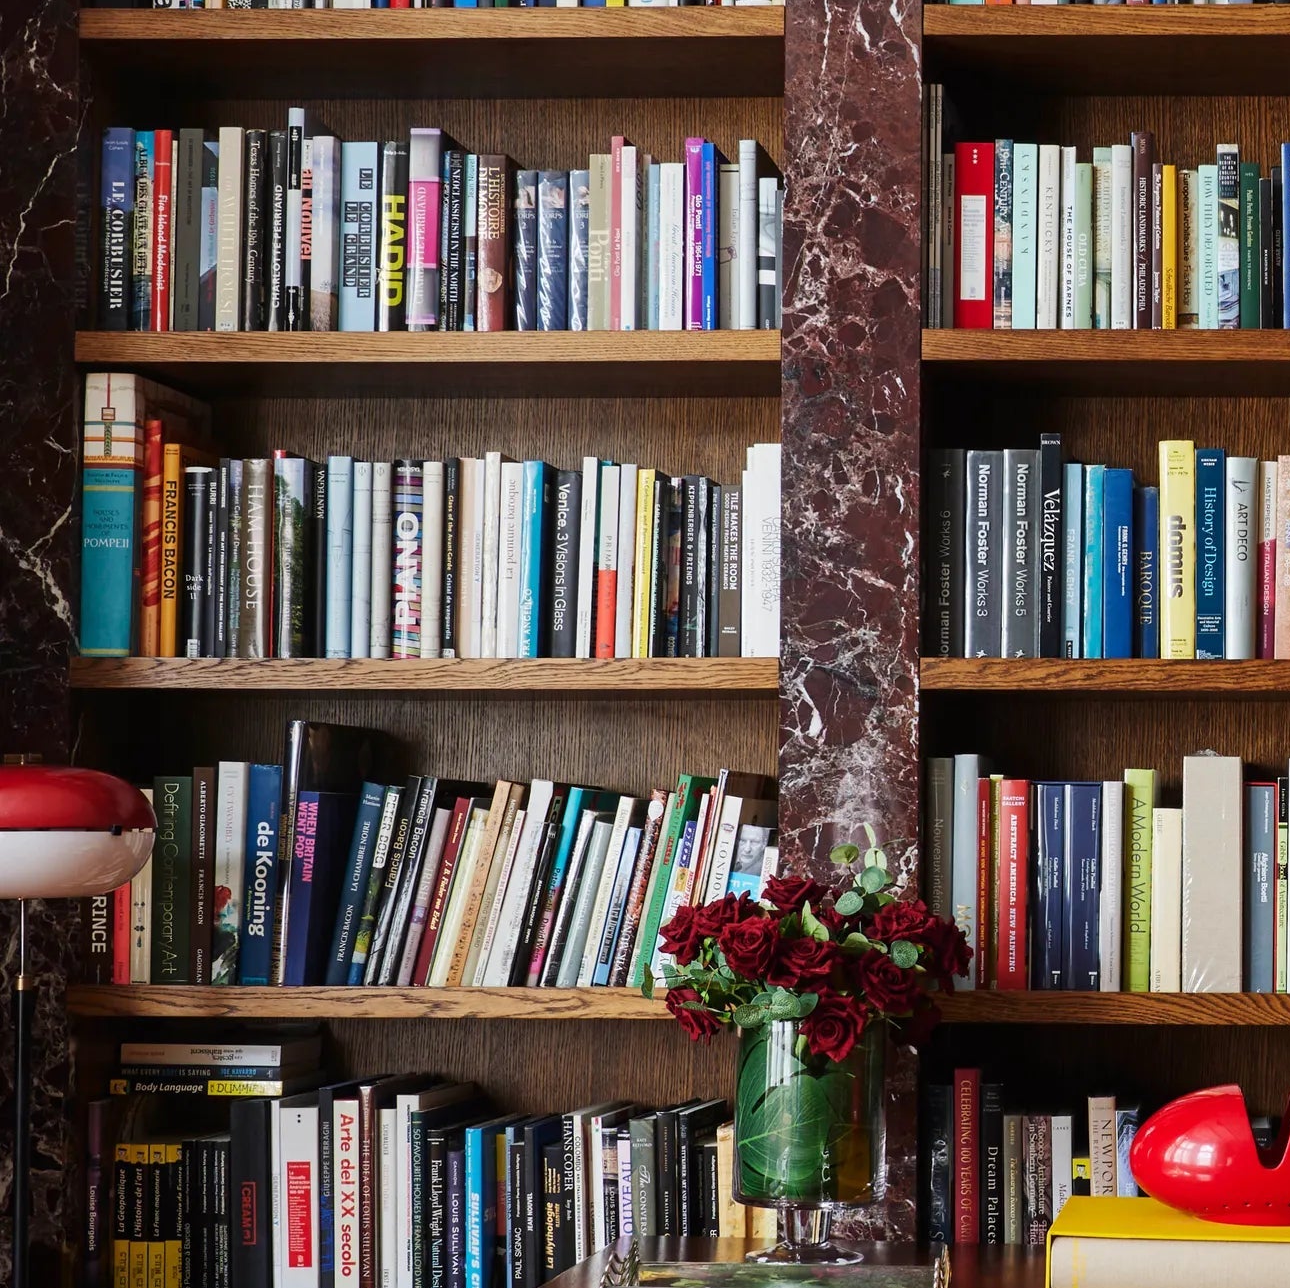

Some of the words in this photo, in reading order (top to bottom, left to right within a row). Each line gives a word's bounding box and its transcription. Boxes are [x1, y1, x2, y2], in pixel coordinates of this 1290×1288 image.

[112, 182, 124, 203] LE
[360, 169, 371, 188] LE
[345, 202, 357, 222] LE
[109, 209, 123, 309] CORBUSIER
[344, 235, 357, 287] GRAND
[359, 202, 371, 297] CORBUSIER
[1078, 233, 1087, 257] OLD
[1077, 260, 1087, 287] CUBA
[247, 485, 262, 533] HAM
[557, 484, 569, 530] Venice.
[1016, 464, 1028, 516] Norman
[164, 481, 176, 544] FRANCIS
[1041, 489, 1059, 571] Velázquez
[1202, 487, 1216, 534] History
[84, 538, 129, 548] POMPEII
[1016, 521, 1028, 564] Foster
[1204, 537, 1215, 550] of
[163, 549, 175, 599] BACON
[246, 541, 262, 609] HOUSE
[395, 512, 418, 624] PIANO
[555, 542, 568, 584] Visions
[1202, 553, 1215, 597] Design
[554, 586, 566, 596] in
[1015, 569, 1027, 606] Works
[1140, 551, 1152, 624] BAROQUE
[553, 599, 566, 631] Glass
[1016, 608, 1026, 616] 5
[296, 801, 307, 832] WENT
[306, 802, 318, 835] WHEN
[1132, 797, 1144, 811] A
[257, 822, 271, 846] de
[295, 835, 305, 858] POP
[1129, 815, 1144, 879] Modern
[302, 838, 315, 882] BRITAIN
[249, 850, 271, 937] Kooning
[1130, 883, 1145, 934] World
[135, 1082, 158, 1093] Body
[160, 1083, 203, 1094] Language
[340, 1114, 354, 1151] Arte
[563, 1121, 573, 1151] HANS
[341, 1159, 355, 1185] del
[563, 1154, 574, 1191] COPER
[988, 1147, 998, 1190] Dream
[342, 1191, 355, 1218] XX
[451, 1193, 459, 1224] LOUIS
[988, 1197, 998, 1245] Palaces
[342, 1224, 355, 1276] secolo
